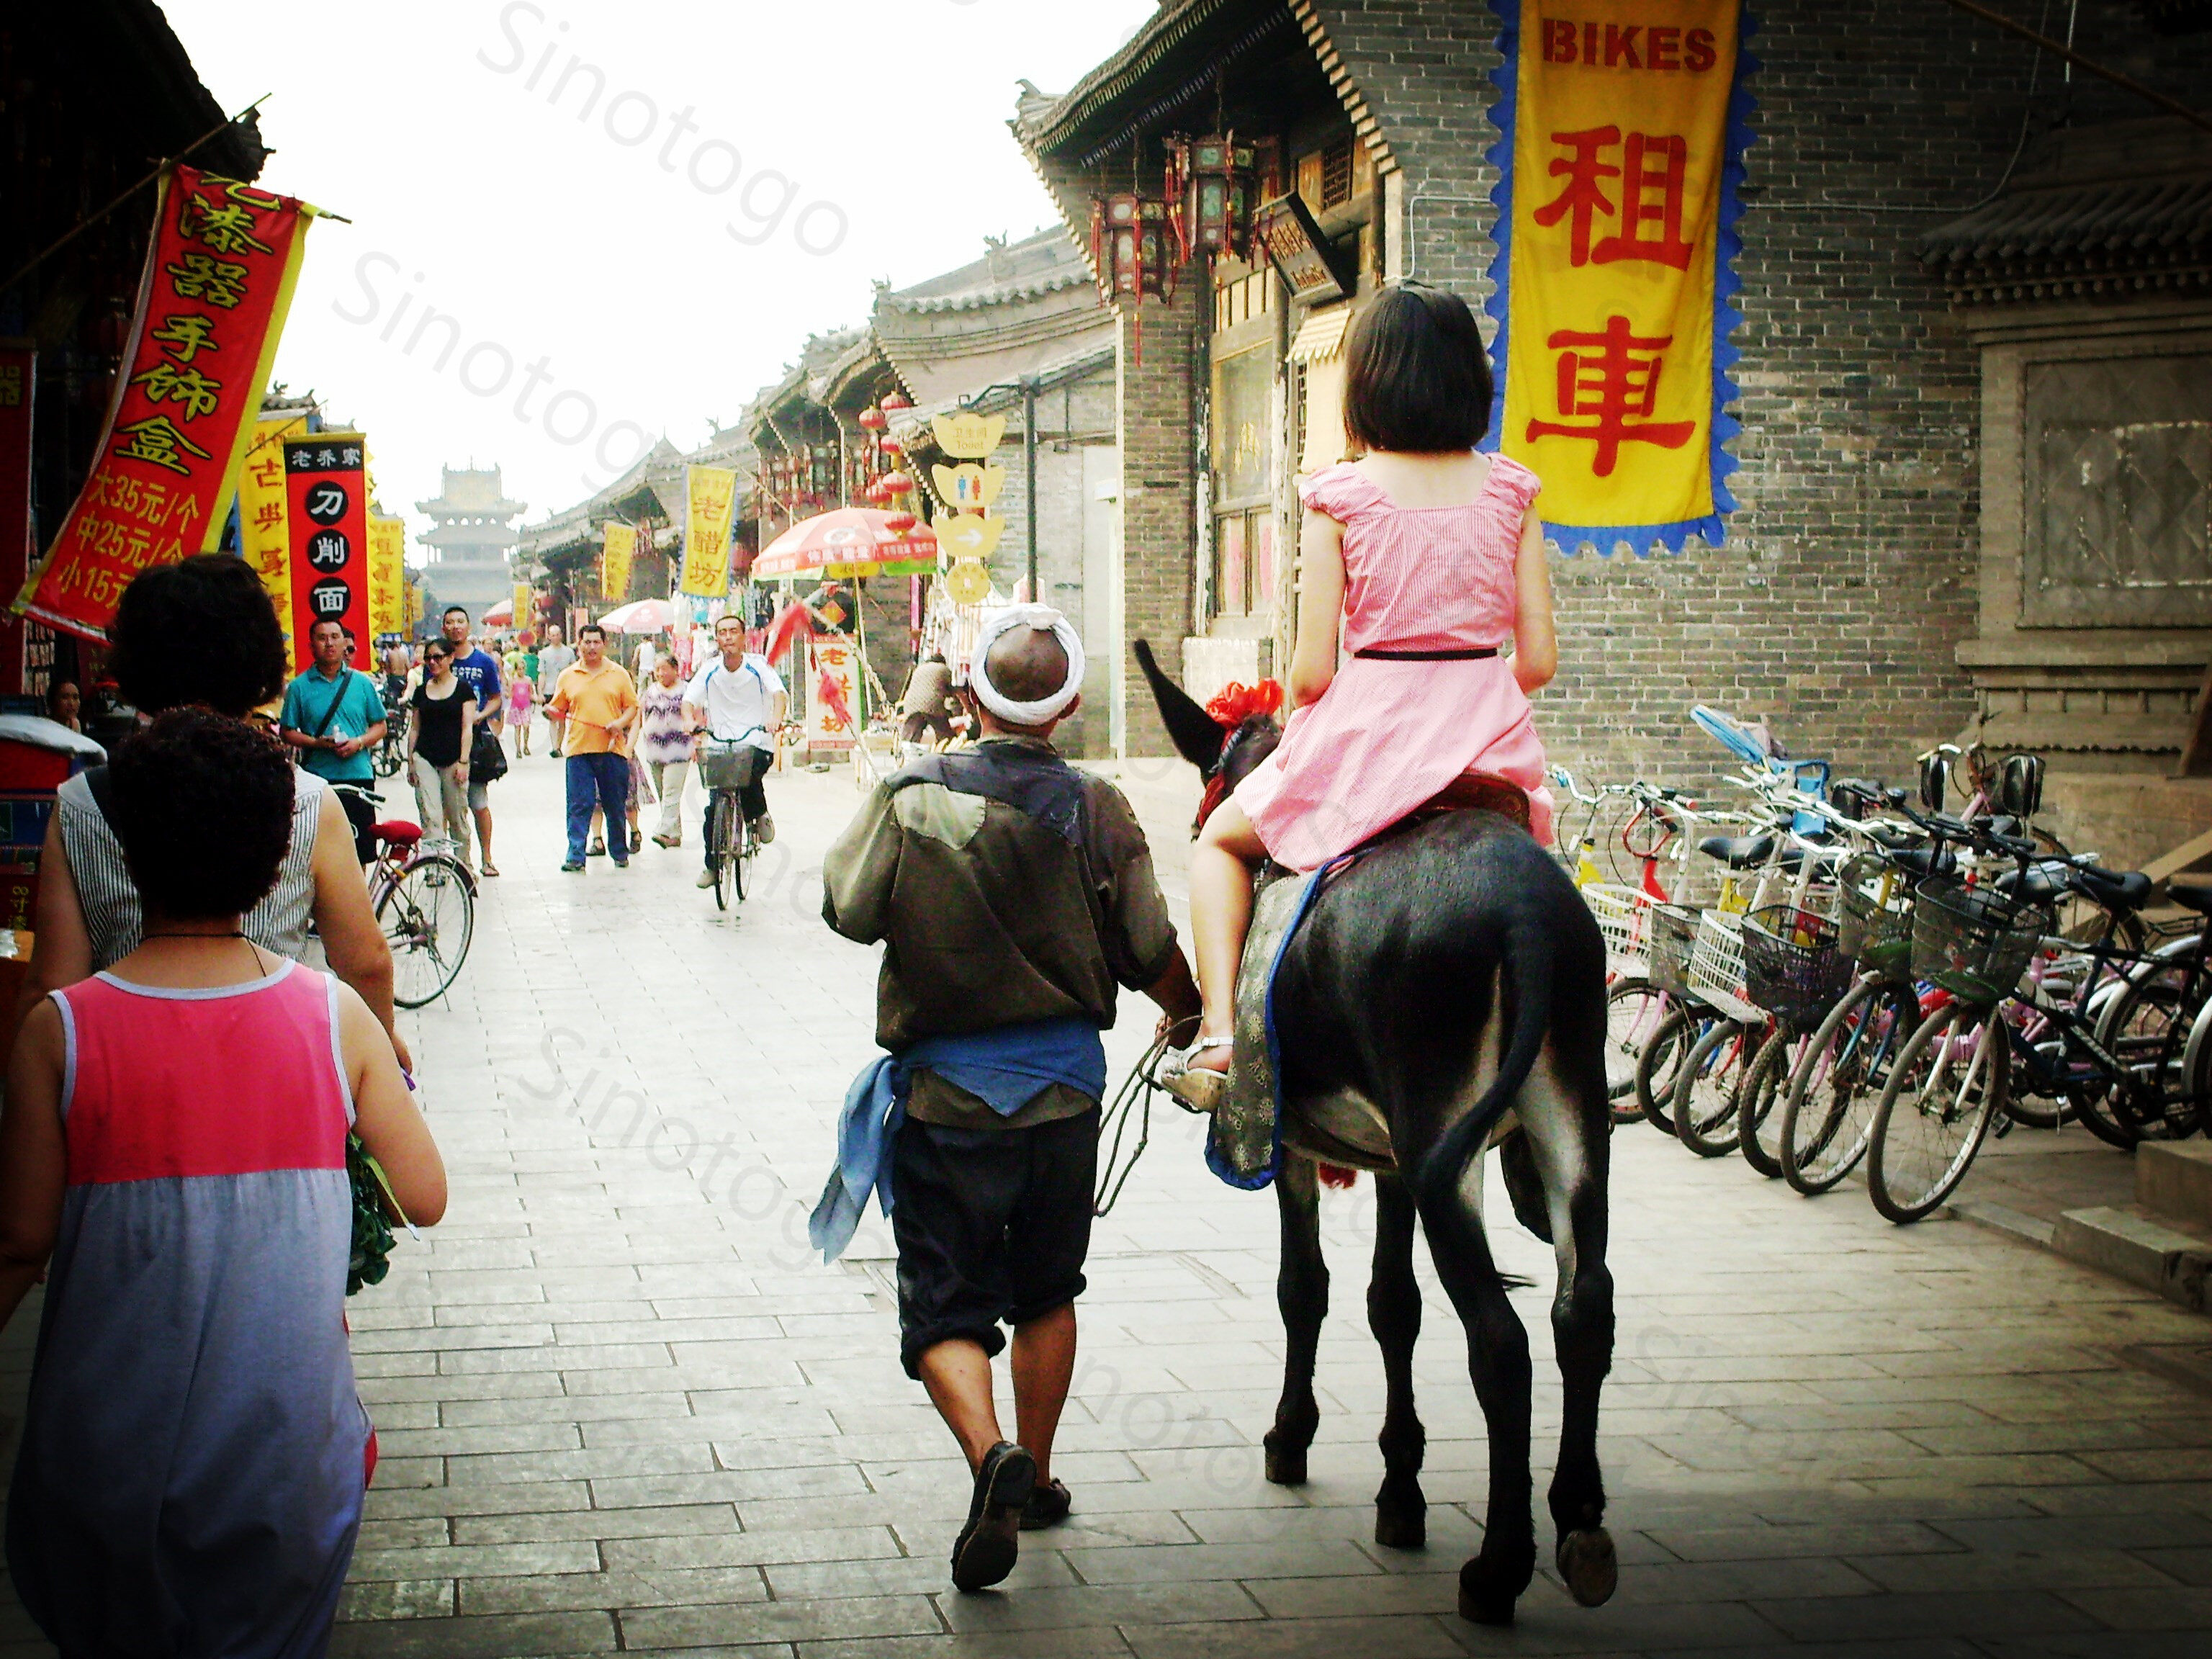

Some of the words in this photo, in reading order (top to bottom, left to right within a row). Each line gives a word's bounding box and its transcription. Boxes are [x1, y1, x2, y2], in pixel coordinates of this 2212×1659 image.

[1542, 19, 1717, 73] BIKES
[1525, 125, 1696, 477] 租車
[953, 427, 987, 438] 卫生间
[87, 464, 199, 535] 大35元/个
[310, 490, 348, 613] 刀削面
[689, 495, 726, 588] 老醋坊
